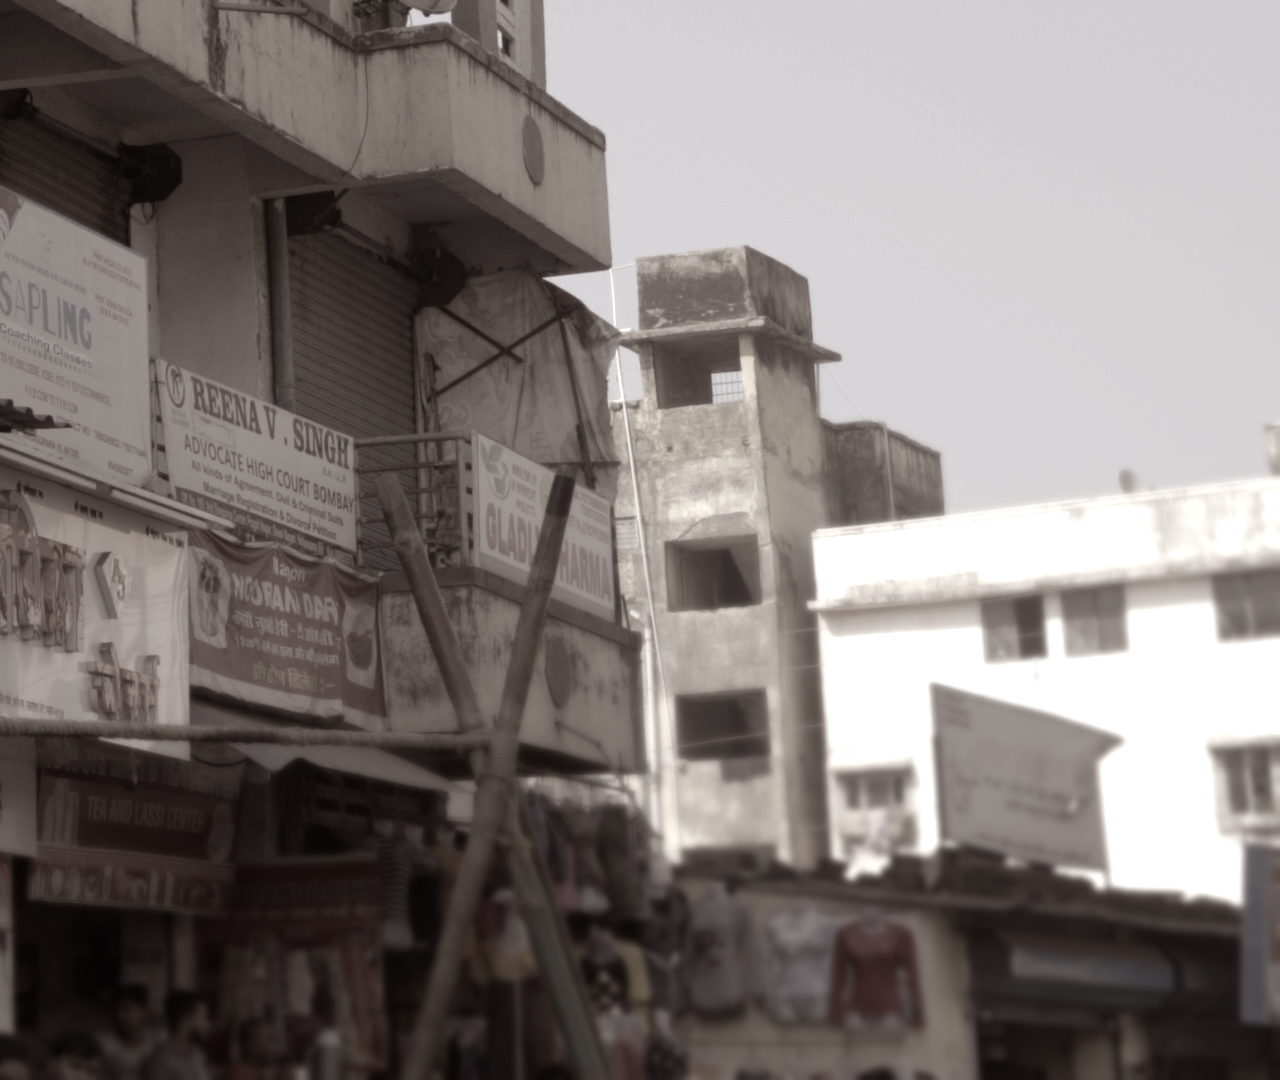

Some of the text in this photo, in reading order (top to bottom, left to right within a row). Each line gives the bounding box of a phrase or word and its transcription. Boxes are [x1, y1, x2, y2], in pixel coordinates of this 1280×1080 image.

[0, 322, 93, 370] Coaching Classes
[191, 377, 262, 436] REENA
[293, 417, 349, 470] SINGH
[184, 433, 354, 514] ADVOCATE HIGH COURT BOMBAY
[87, 795, 204, 835] TEA AND LASSI CENTER
